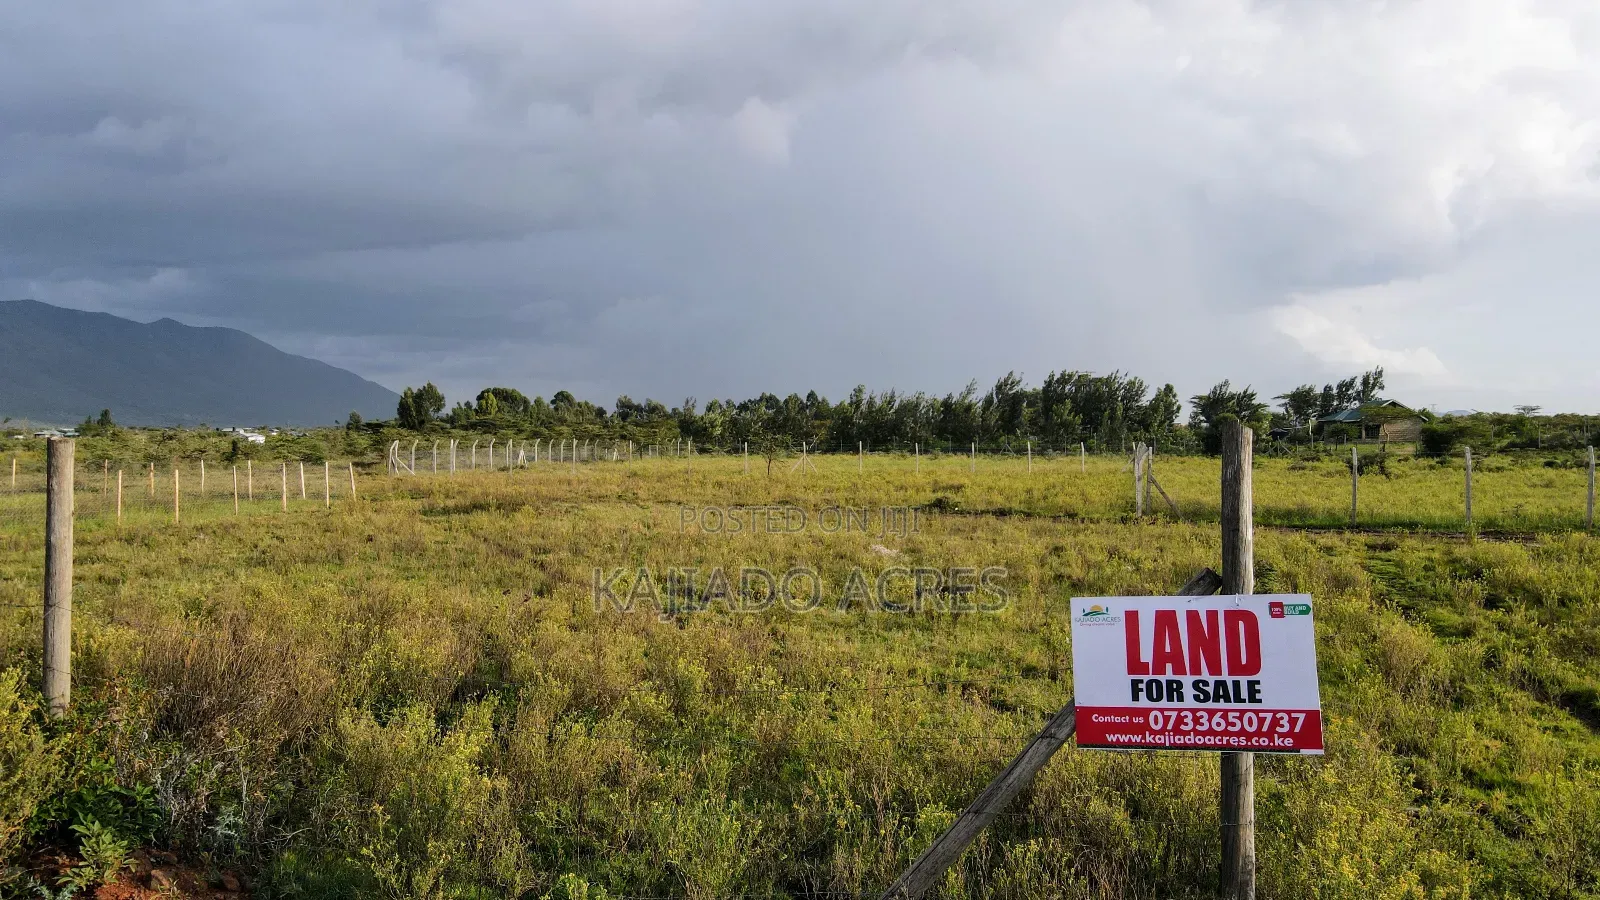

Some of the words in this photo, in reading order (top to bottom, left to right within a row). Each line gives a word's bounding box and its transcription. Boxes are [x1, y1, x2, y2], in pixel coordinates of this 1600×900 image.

[1124, 609, 1262, 676] LAND
[1130, 678, 1185, 703] FOR
[1191, 679, 1263, 704] SALE
[1091, 713, 1130, 723] Contact
[1131, 715, 1144, 724] us
[1148, 710, 1306, 733] 0733650737
[1105, 731, 1294, 747] www.kajiadoacres.co.ke
